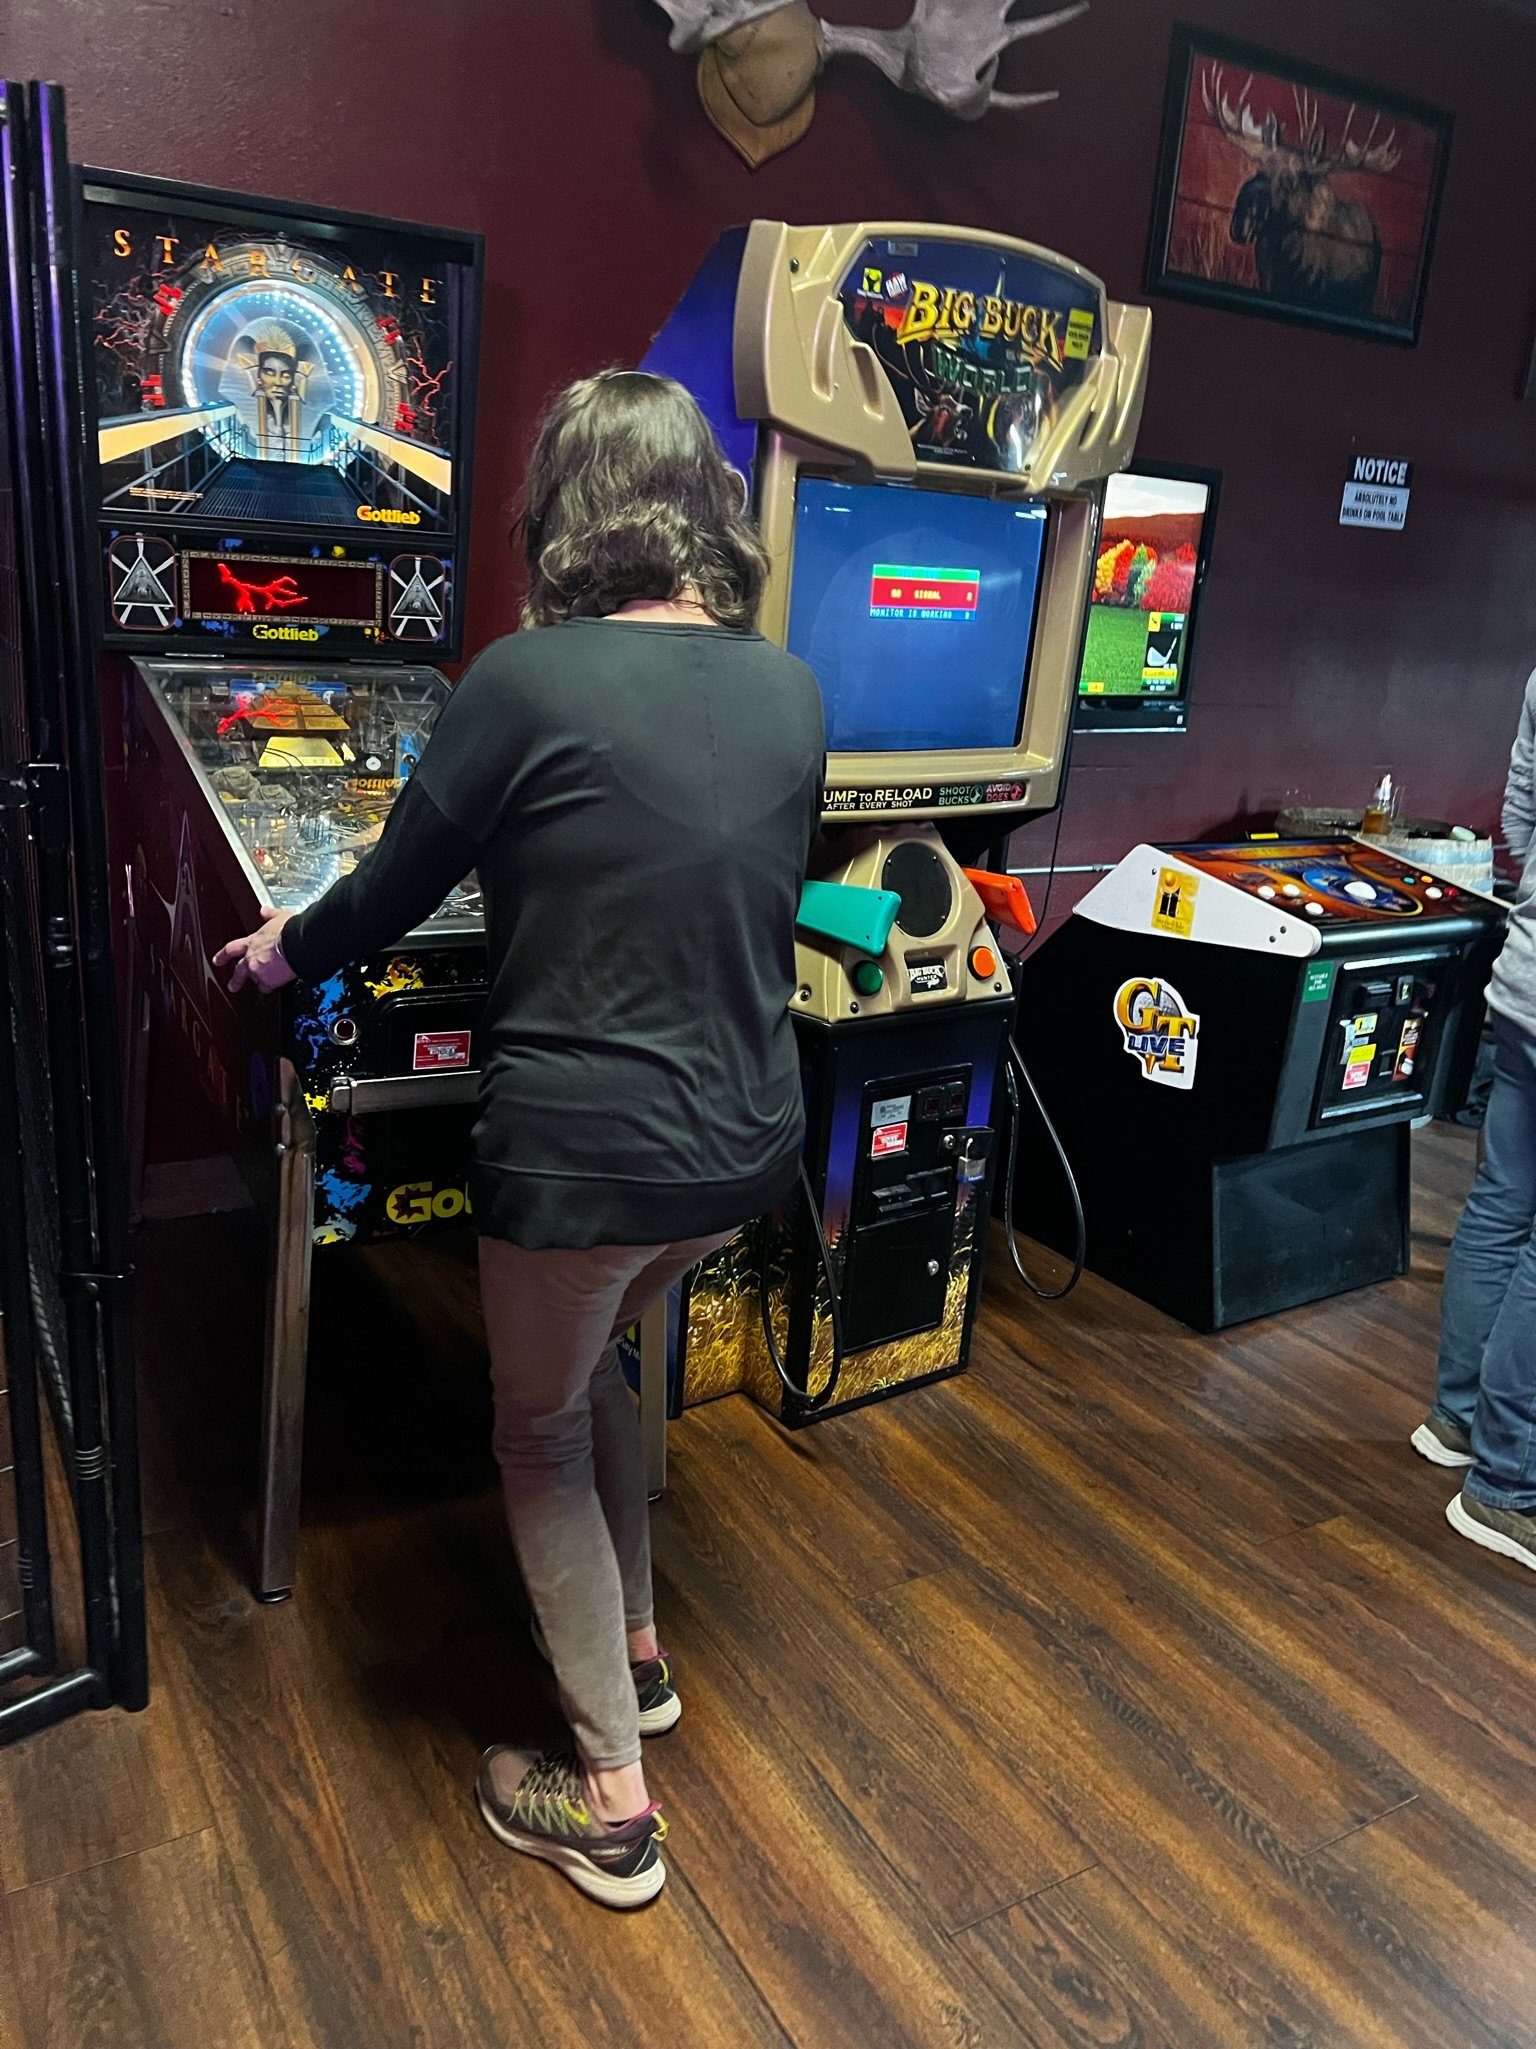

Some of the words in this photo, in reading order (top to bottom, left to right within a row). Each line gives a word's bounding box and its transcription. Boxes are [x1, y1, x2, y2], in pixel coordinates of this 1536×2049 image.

[113, 229, 439, 305] STARGATE
[897, 281, 976, 344] BIG
[978, 296, 1063, 373] BUCK
[935, 347, 1033, 398] WORLD
[1354, 457, 1408, 486] NOTICE
[1355, 492, 1389, 505] ABSOLUTELY
[1389, 495, 1398, 505] NO
[357, 505, 421, 525] Gottlieb
[891, 588, 902, 599] NO
[870, 608, 904, 617] MONITOR
[908, 609, 917, 618] IS
[921, 610, 952, 619] WORKING
[253, 624, 319, 641] Gottlieb
[823, 790, 857, 803] UMP
[875, 787, 932, 801] RELOAD
[939, 785, 971, 796] SHOOT
[986, 783, 1011, 793] AVOID
[938, 796, 970, 806] BUCKS
[986, 792, 1009, 802] DOES
[826, 801, 855, 810] AFTER
[859, 800, 887, 809] EVERY
[891, 799, 913, 808] SHOT
[1127, 1035, 1186, 1057] LIVE
